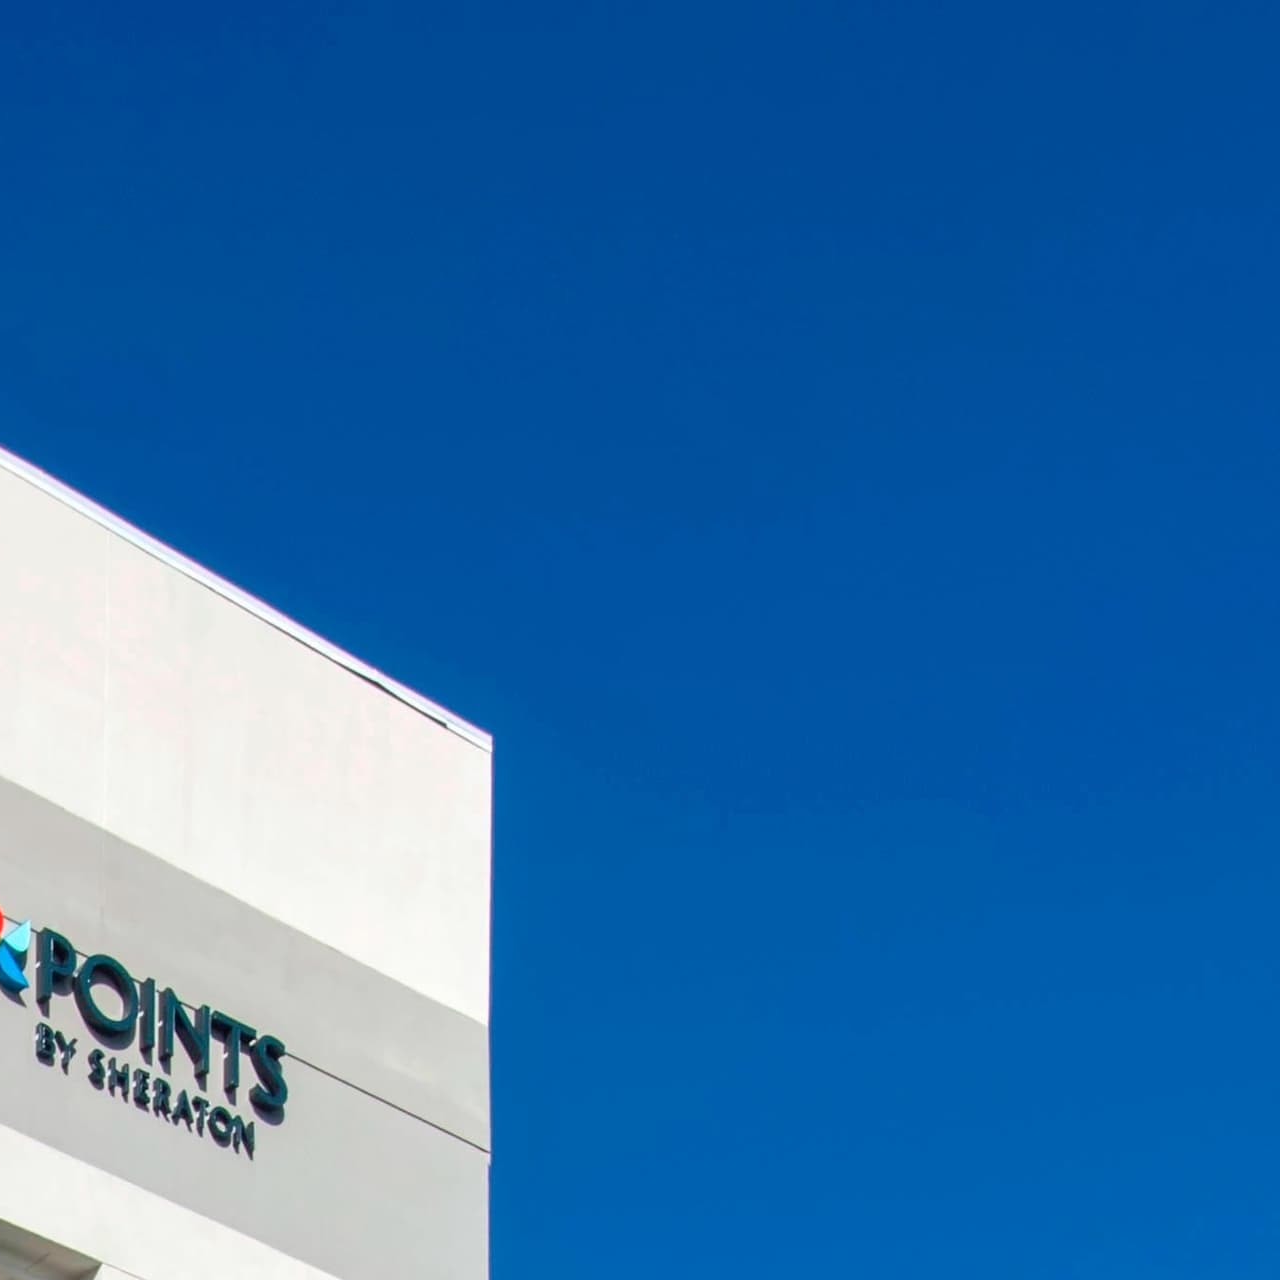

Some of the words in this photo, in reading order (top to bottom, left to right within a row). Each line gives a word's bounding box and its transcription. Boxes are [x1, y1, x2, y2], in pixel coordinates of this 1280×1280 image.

[35, 1022, 78, 1070] BY
[88, 1048, 256, 1156] SHERATON
[36, 927, 288, 1108] POINTS
